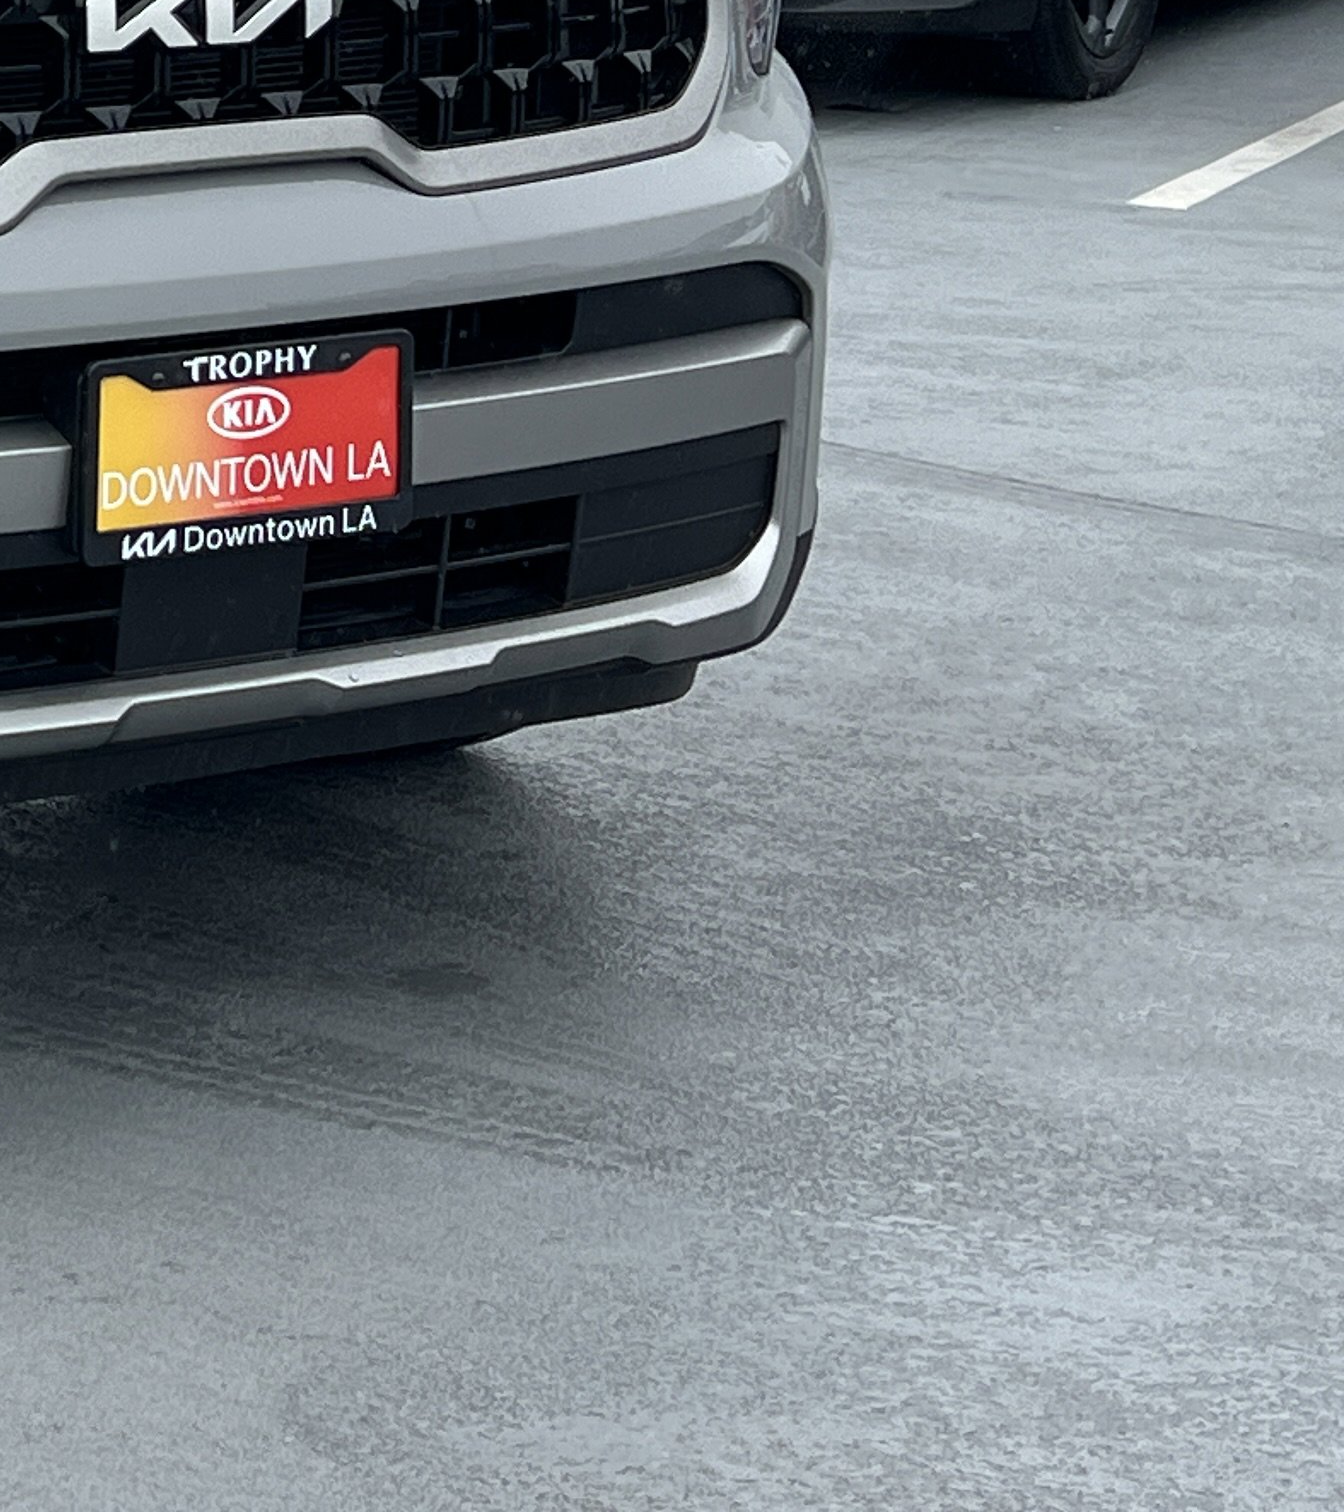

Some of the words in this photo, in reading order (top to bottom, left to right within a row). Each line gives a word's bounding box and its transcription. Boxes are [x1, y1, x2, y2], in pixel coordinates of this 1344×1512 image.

[183, 344, 317, 383] TROPHY
[222, 397, 277, 429] KIA
[100, 445, 334, 512] DOWNTOWN
[348, 439, 392, 482] LA
[121, 528, 176, 561] KIA
[184, 514, 335, 553] Downtown
[342, 504, 378, 535] LA
